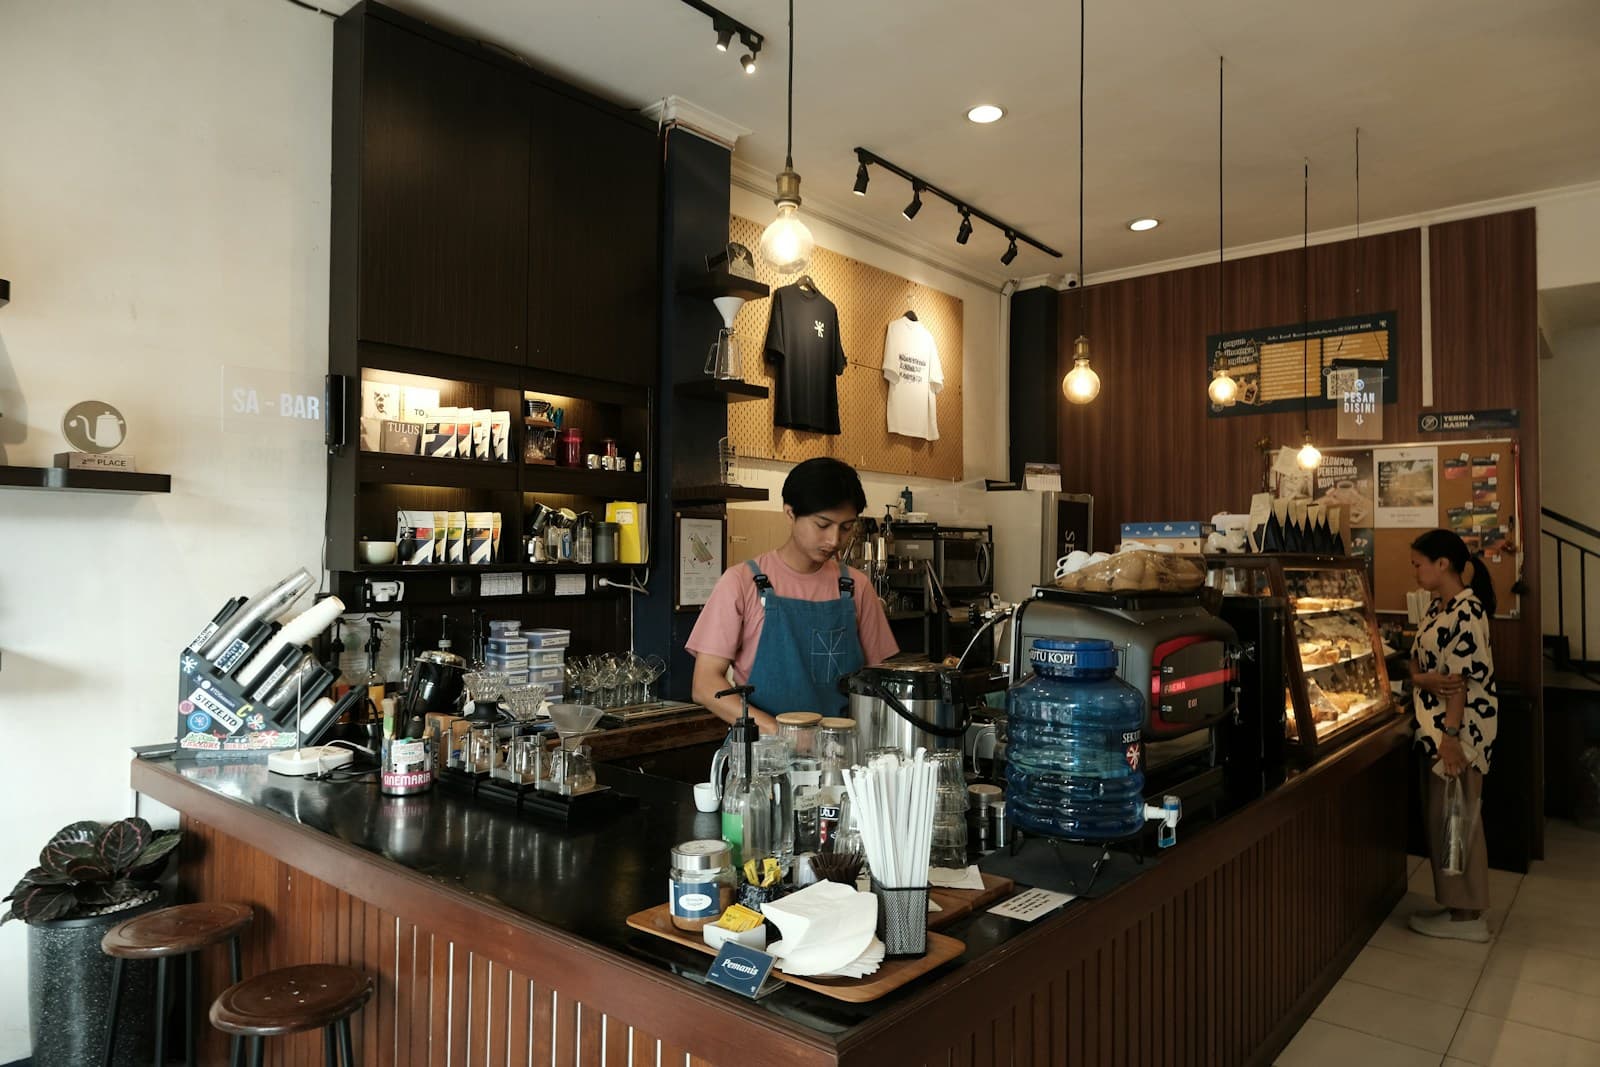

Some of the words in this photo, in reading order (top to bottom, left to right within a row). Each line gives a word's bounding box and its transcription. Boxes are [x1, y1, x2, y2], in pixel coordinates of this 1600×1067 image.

[1343, 391, 1375, 403] PESAN
[232, 387, 260, 415] SA
[280, 392, 320, 420] BAR
[1343, 402, 1375, 414] DISINI
[387, 421, 421, 435] TULUS
[1443, 421, 1469, 429] KASIH
[97, 458, 127, 468] PLACE
[1048, 652, 1074, 665] KOPI
[721, 958, 759, 976] Pemanis
